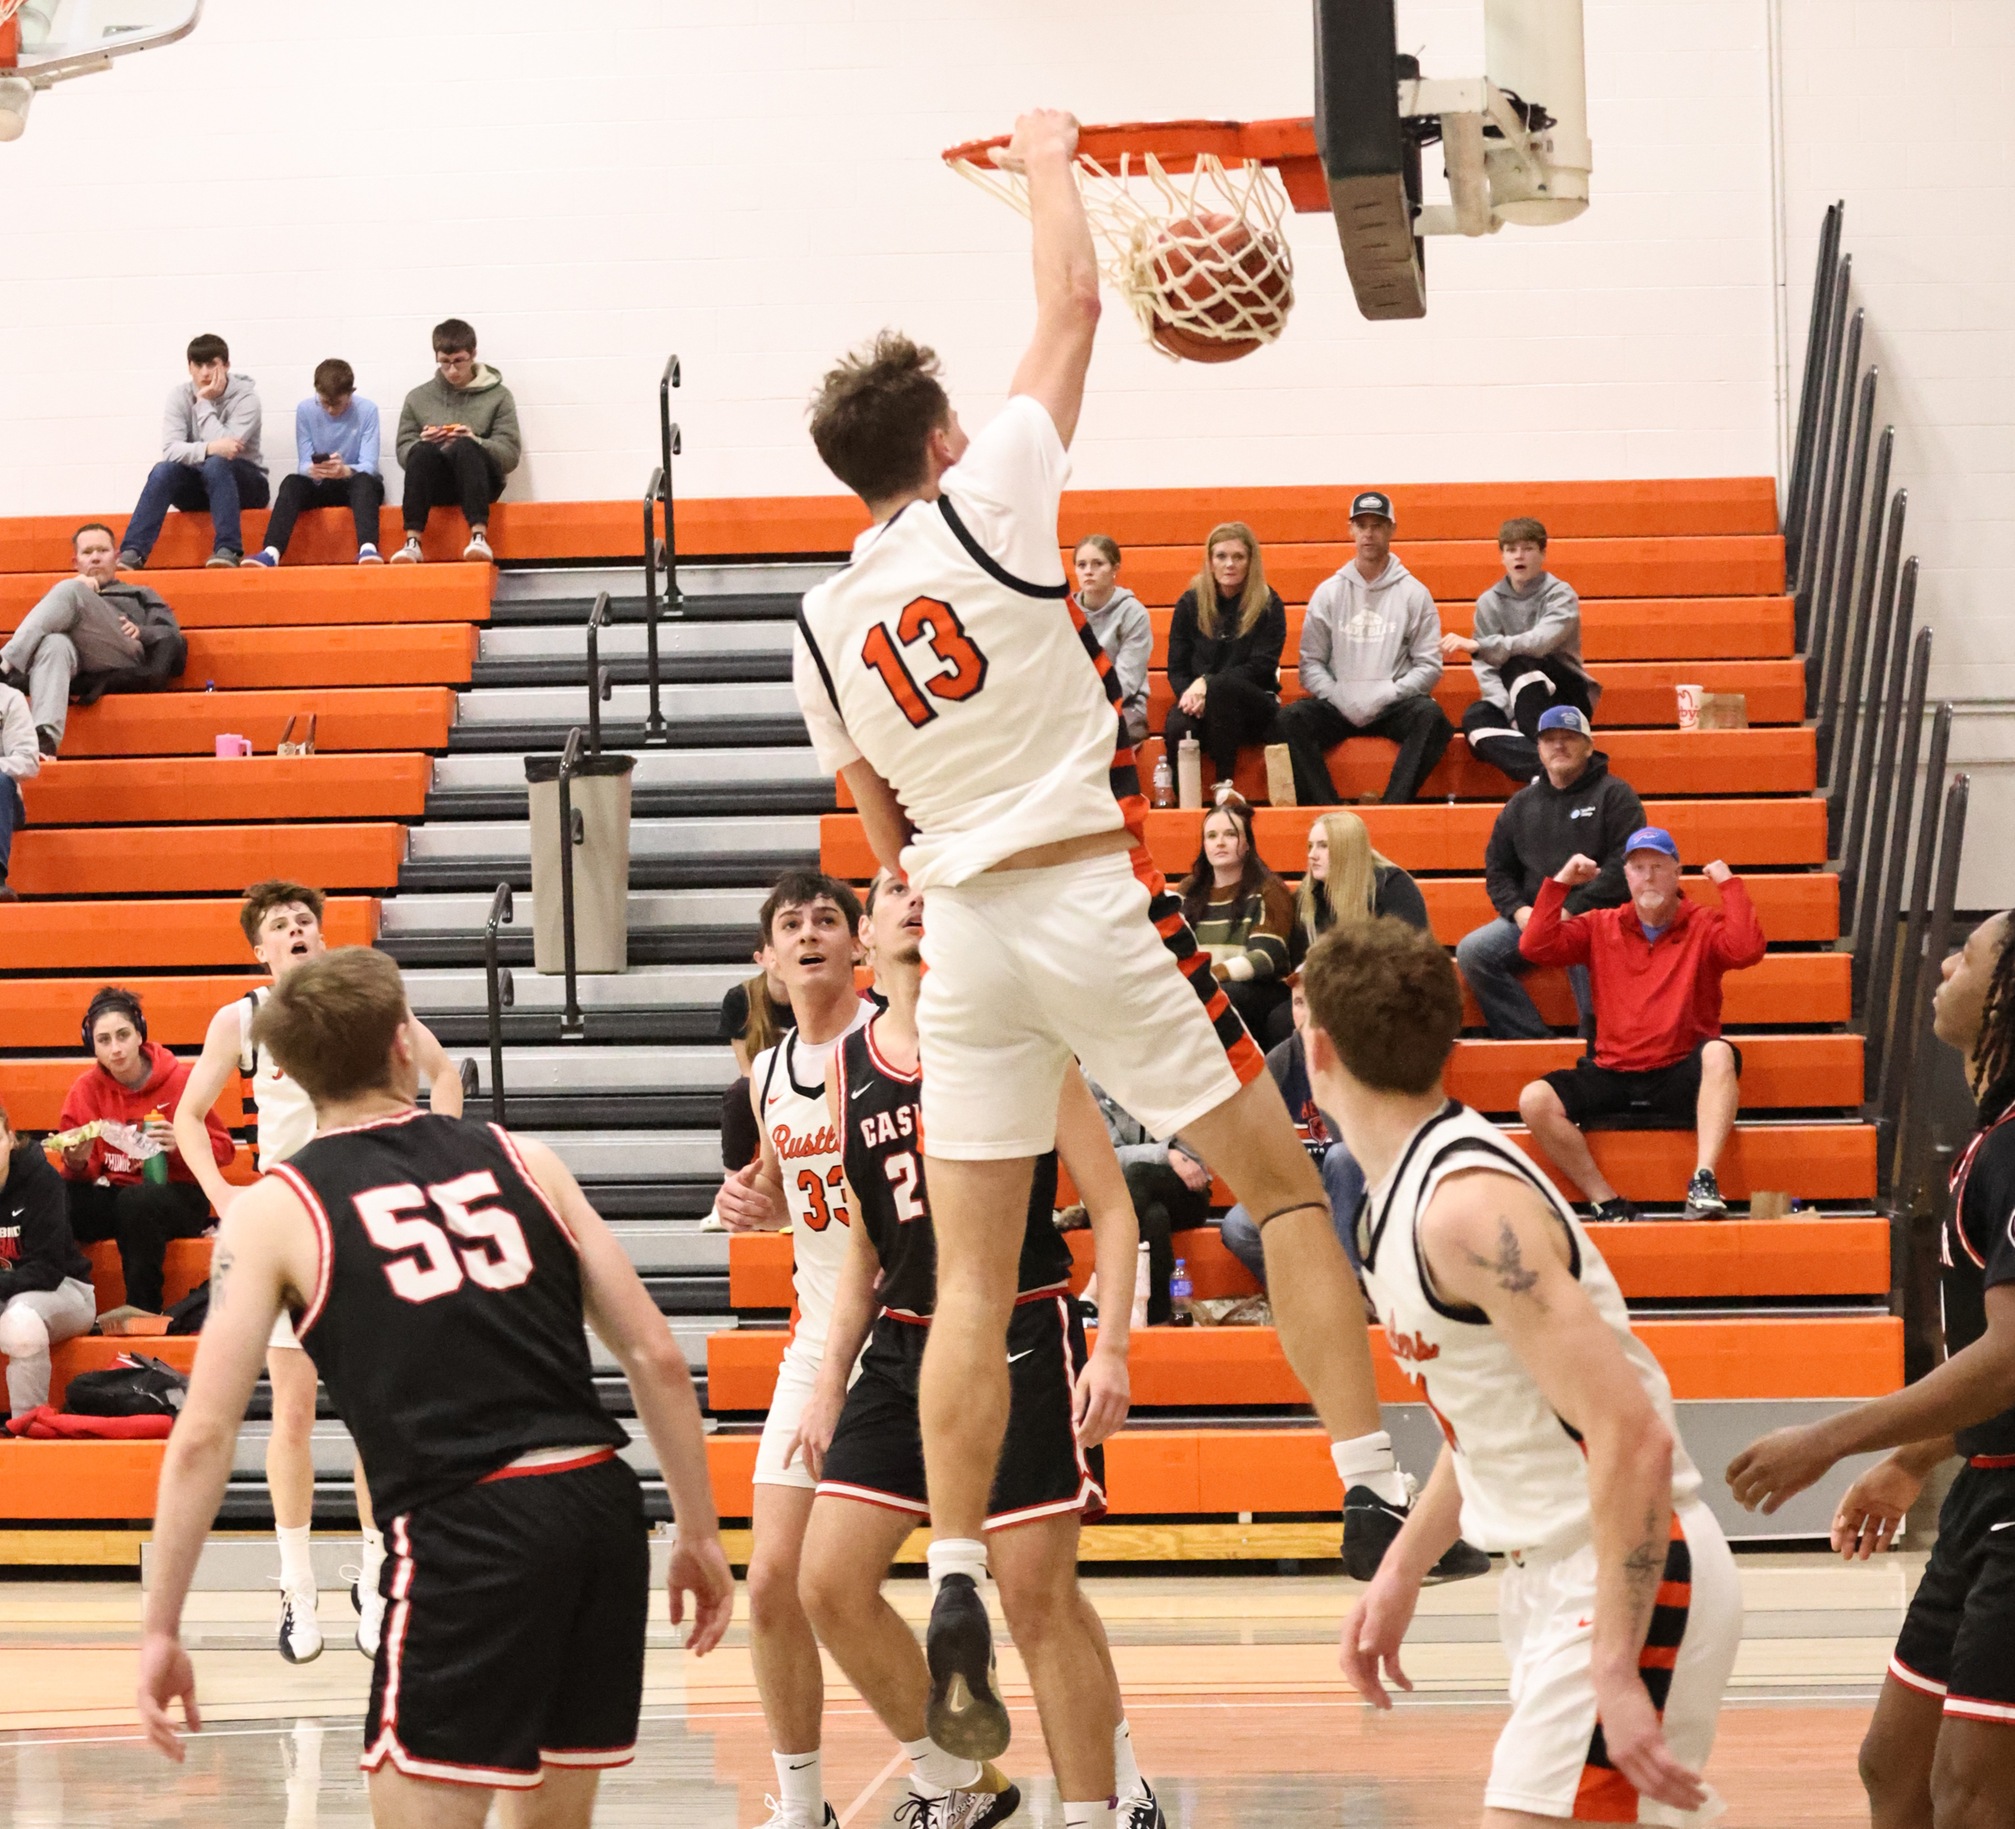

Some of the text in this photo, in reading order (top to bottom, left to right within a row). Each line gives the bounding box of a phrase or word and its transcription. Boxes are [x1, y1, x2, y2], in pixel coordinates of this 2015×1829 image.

[861, 595, 989, 729] 13
[350, 1167, 536, 1306] 55
[797, 1165, 850, 1232] 33
